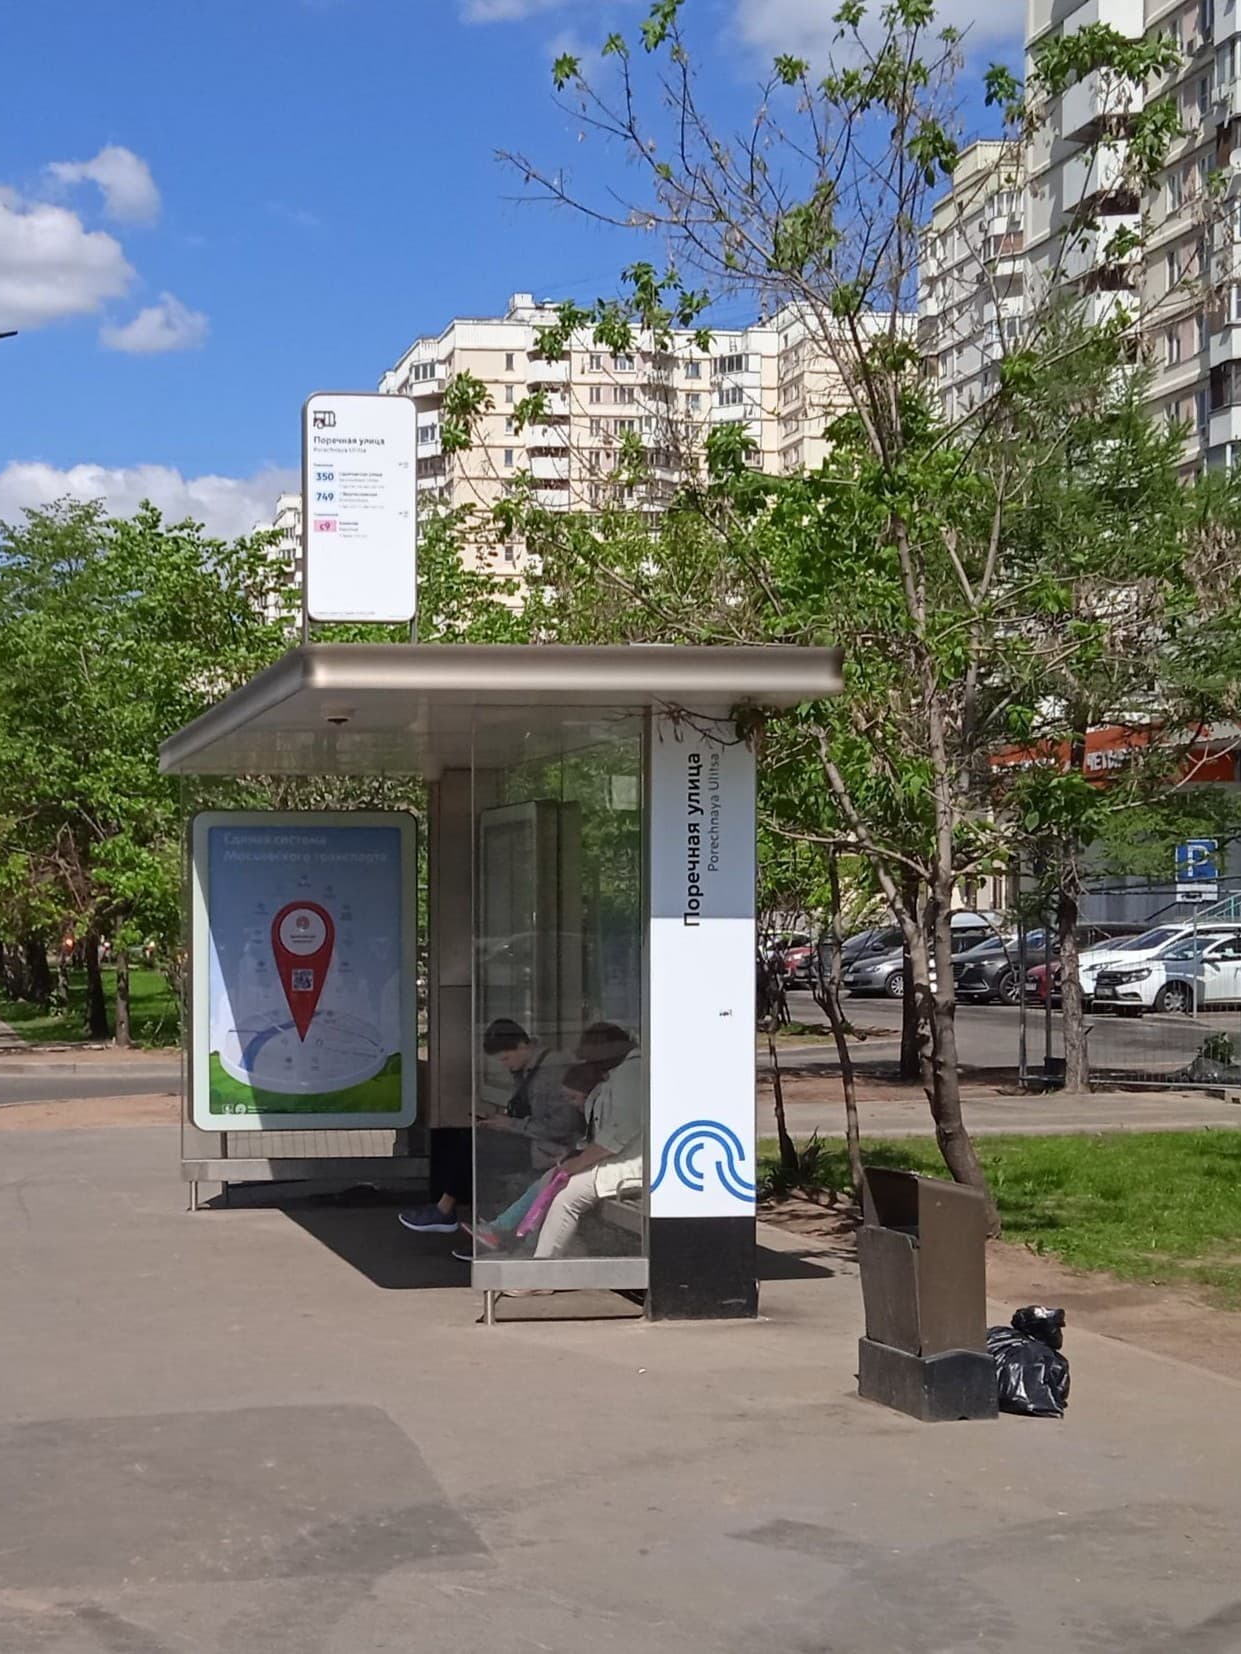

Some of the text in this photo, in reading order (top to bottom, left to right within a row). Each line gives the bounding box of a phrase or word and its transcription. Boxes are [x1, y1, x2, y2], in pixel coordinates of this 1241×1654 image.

[313, 435, 385, 447] Поречная улица
[316, 472, 334, 481] 350
[316, 492, 334, 501] 749
[707, 753, 721, 872] Porechnaya Ulitsa
[683, 753, 704, 927] Поречная улица
[1187, 845, 1210, 877] P
